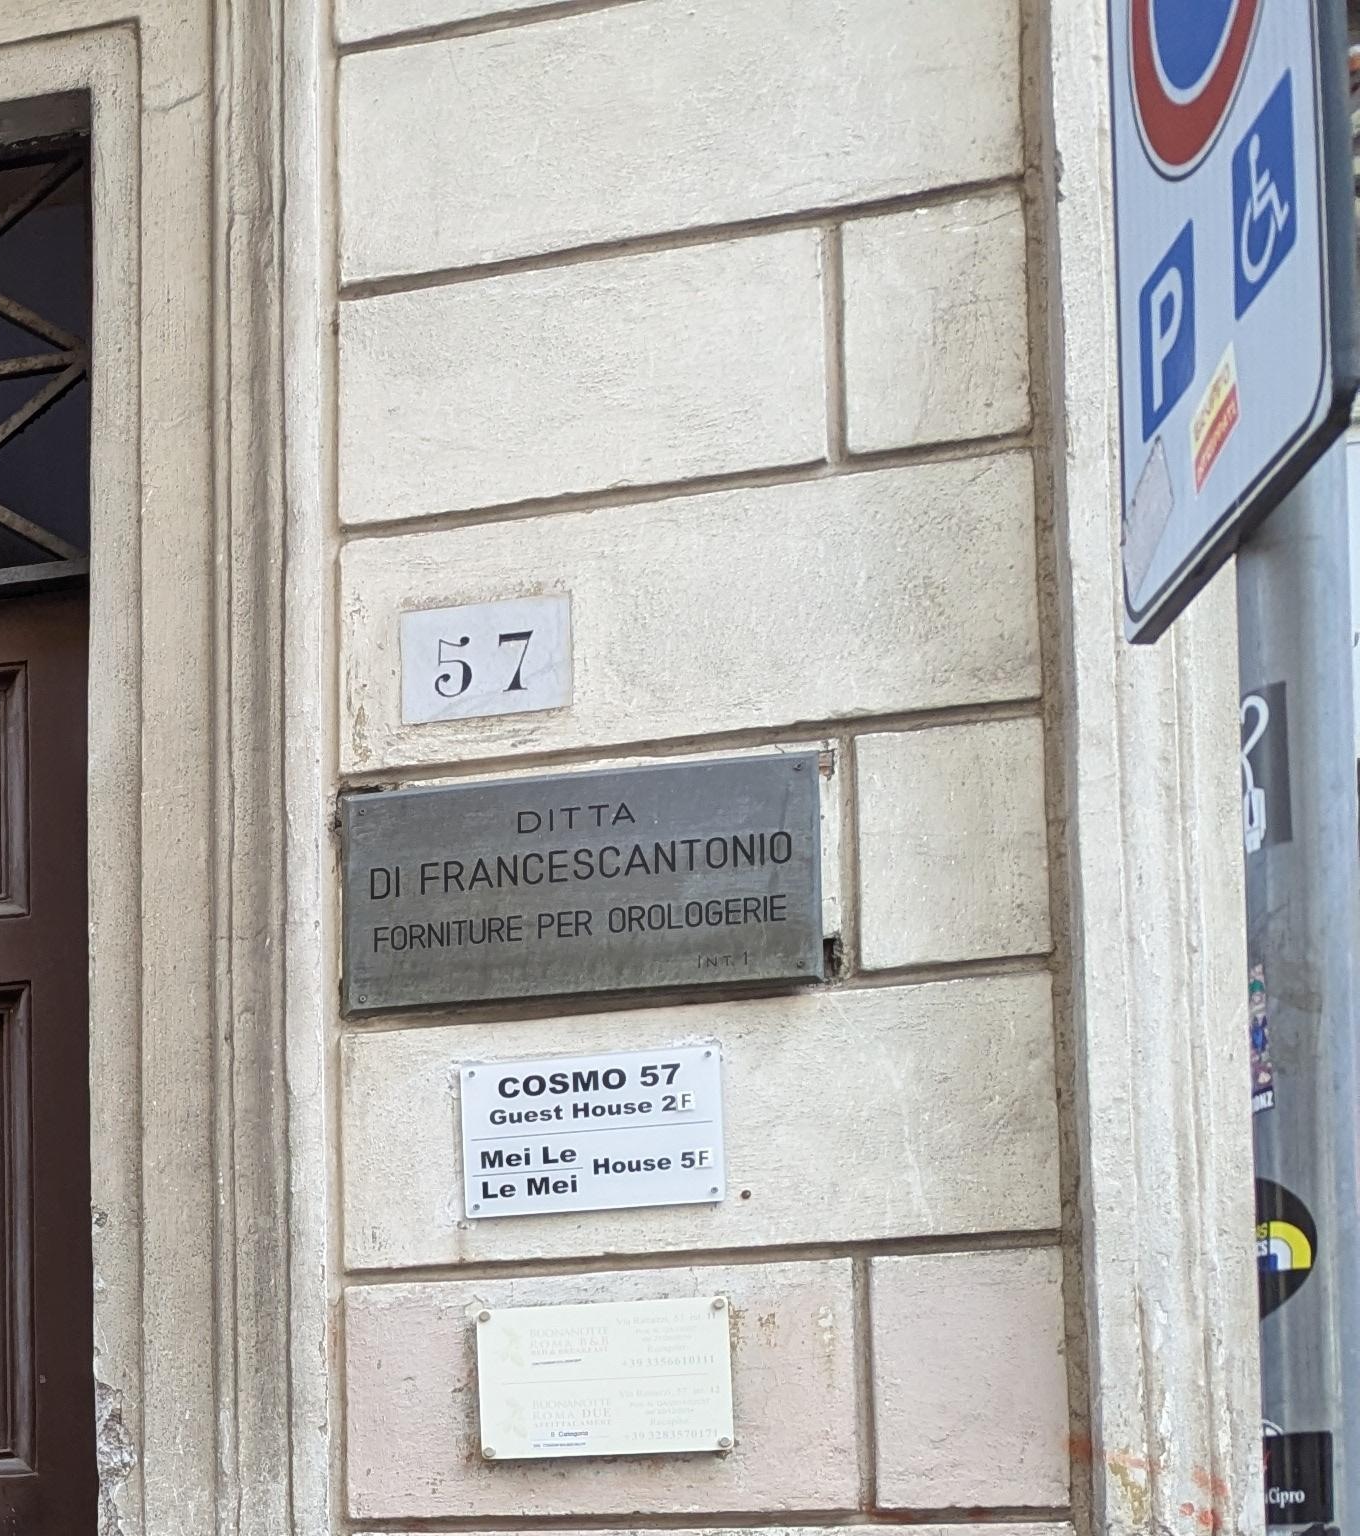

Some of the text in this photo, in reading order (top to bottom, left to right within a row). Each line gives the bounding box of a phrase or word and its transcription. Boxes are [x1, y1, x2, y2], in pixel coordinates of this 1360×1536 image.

[1152, 266, 1182, 411] P
[434, 629, 534, 698] 57
[517, 802, 636, 834] DITTA
[370, 831, 792, 900] DI FRANCESCANTONIO
[373, 895, 787, 952] FORNITURE PER OROLOGERIE
[498, 1063, 681, 1098] COSMO 57
[489, 1105, 563, 1125] Guest
[572, 1101, 652, 1118] House
[480, 1146, 577, 1169] Mei Le
[593, 1156, 672, 1175] House
[482, 1175, 577, 1199] Le Mei
